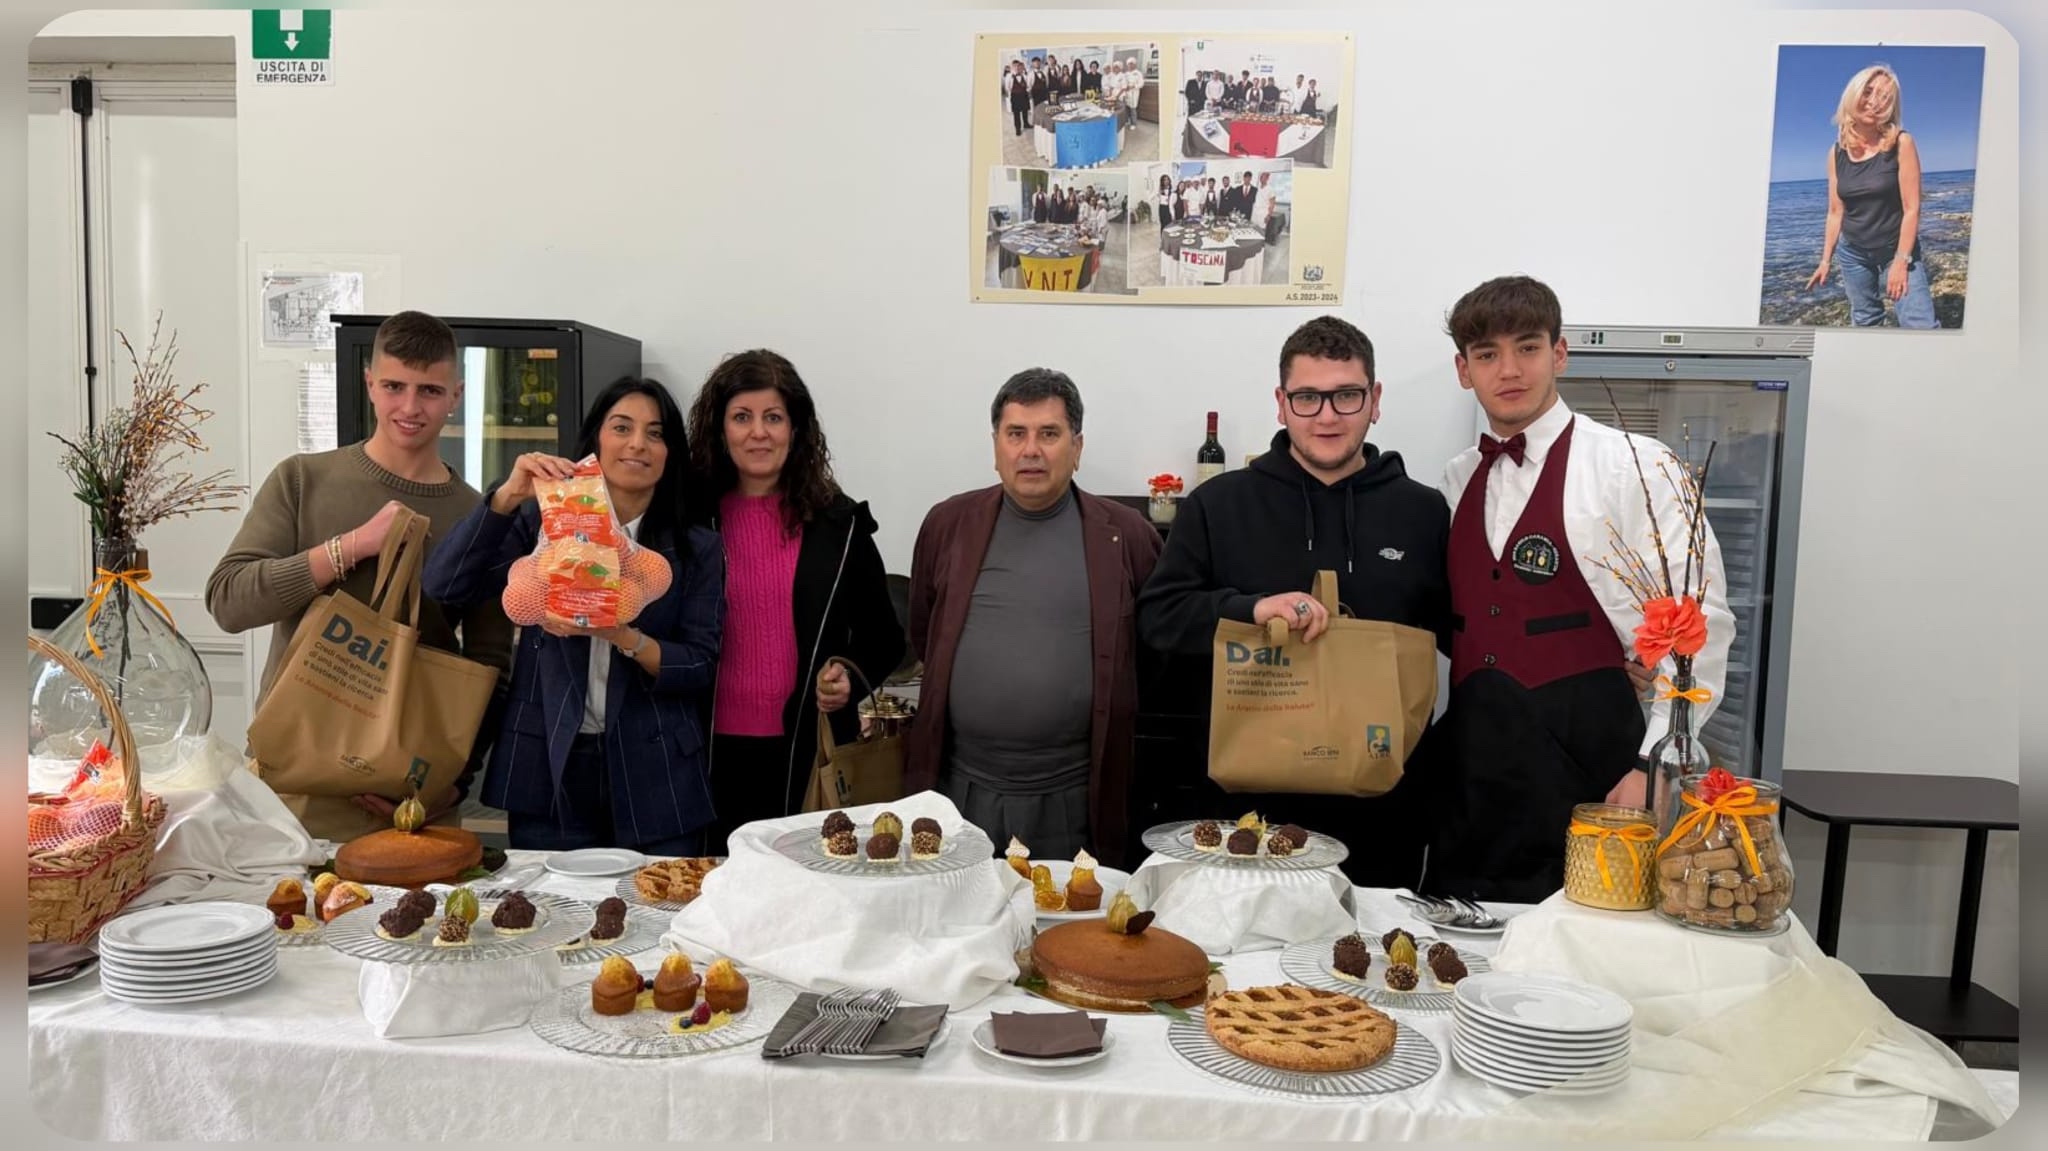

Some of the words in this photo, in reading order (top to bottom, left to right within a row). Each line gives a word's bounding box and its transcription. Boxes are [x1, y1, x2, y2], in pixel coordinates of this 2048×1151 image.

[260, 61, 306, 72] USCITA
[310, 61, 324, 72] DI
[256, 73, 327, 83] EMERGENZA
[1182, 250, 1225, 265] TOSCANA
[322, 613, 389, 671] Dai.
[314, 641, 336, 657] Credi
[332, 664, 349, 677] stile
[358, 678, 372, 690] vita
[1227, 668, 1249, 676] Credi
[339, 678, 348, 688] la
[1250, 679, 1265, 687] stile
[1273, 680, 1290, 688] vita
